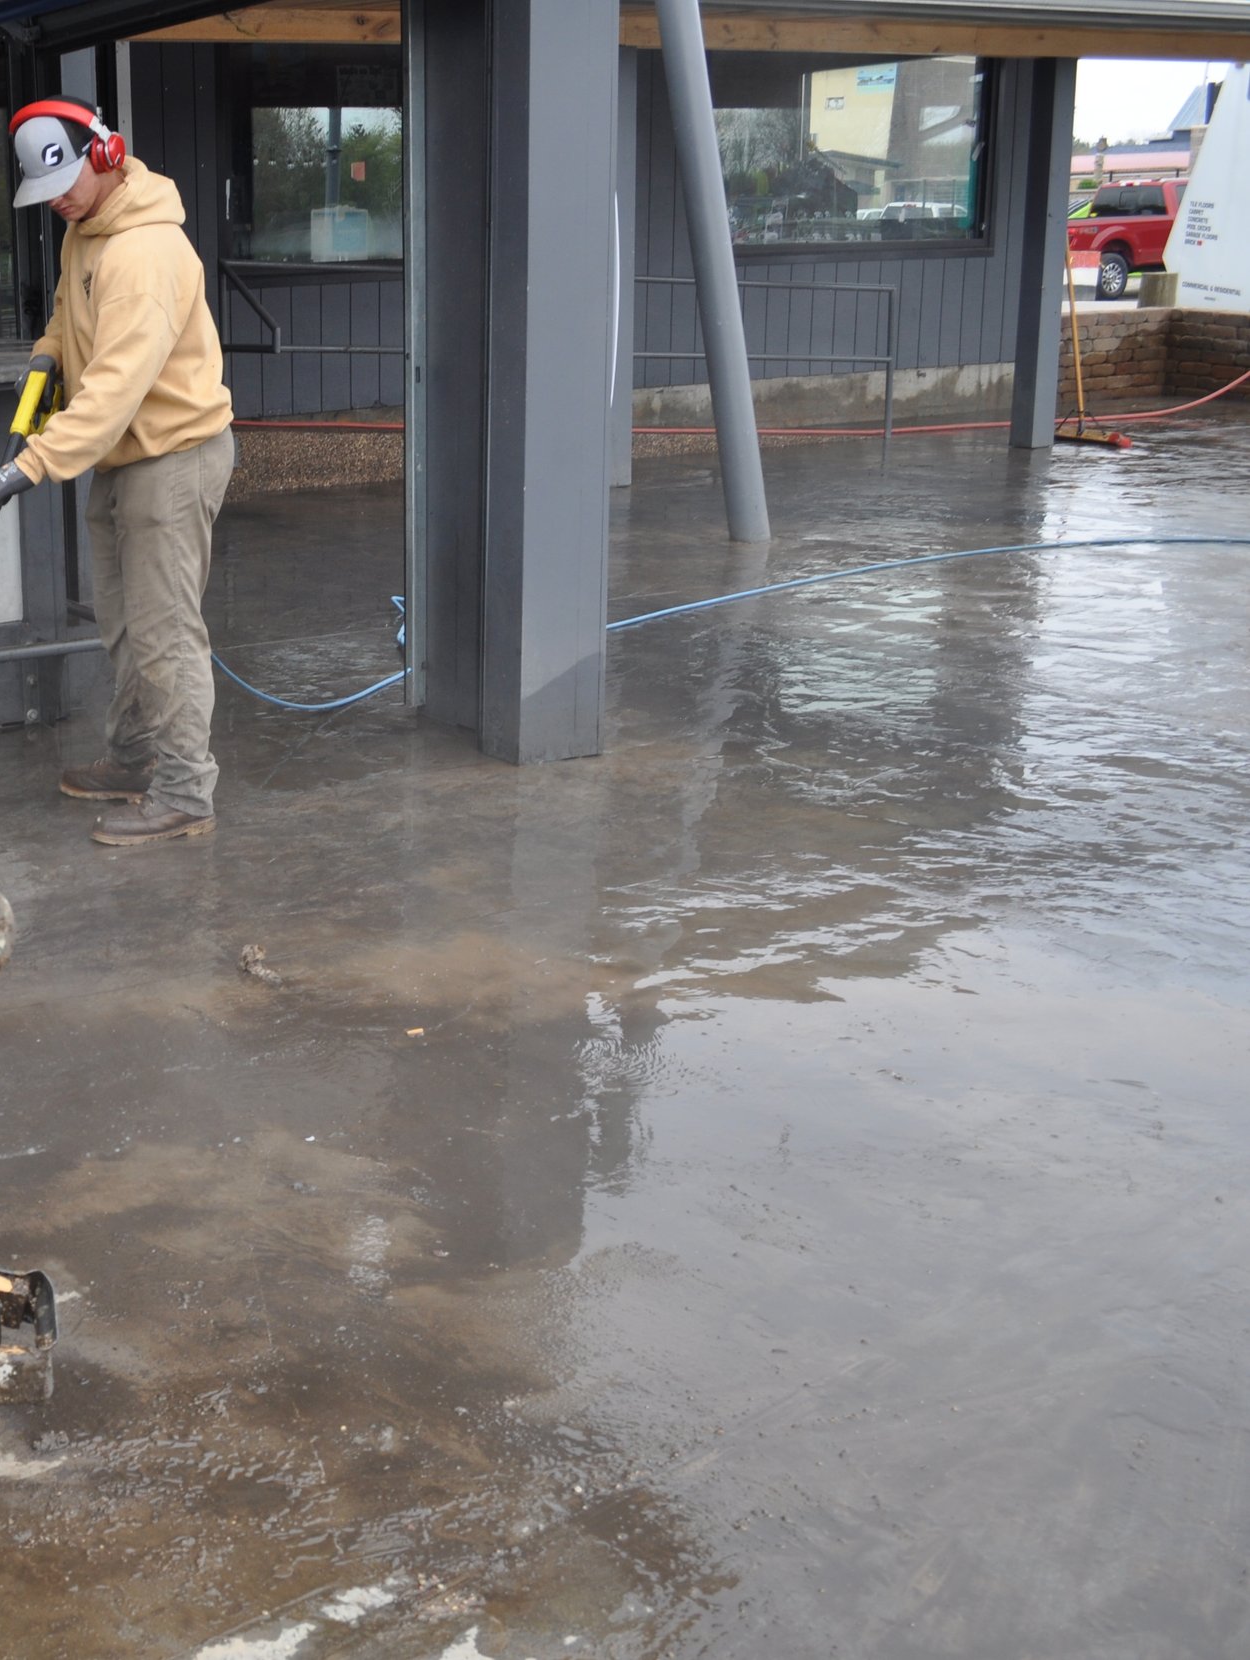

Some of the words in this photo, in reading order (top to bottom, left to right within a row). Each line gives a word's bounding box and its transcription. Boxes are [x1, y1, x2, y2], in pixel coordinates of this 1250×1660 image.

[1189, 208, 1204, 216] CARPET
[1187, 216, 1208, 224] CONCRETE
[1185, 231, 1201, 239] GARAGE
[1201, 233, 1218, 241] FLOORS
[1181, 281, 1209, 291] COMMERCIAL
[1214, 286, 1241, 297] RESIDENTIAL
